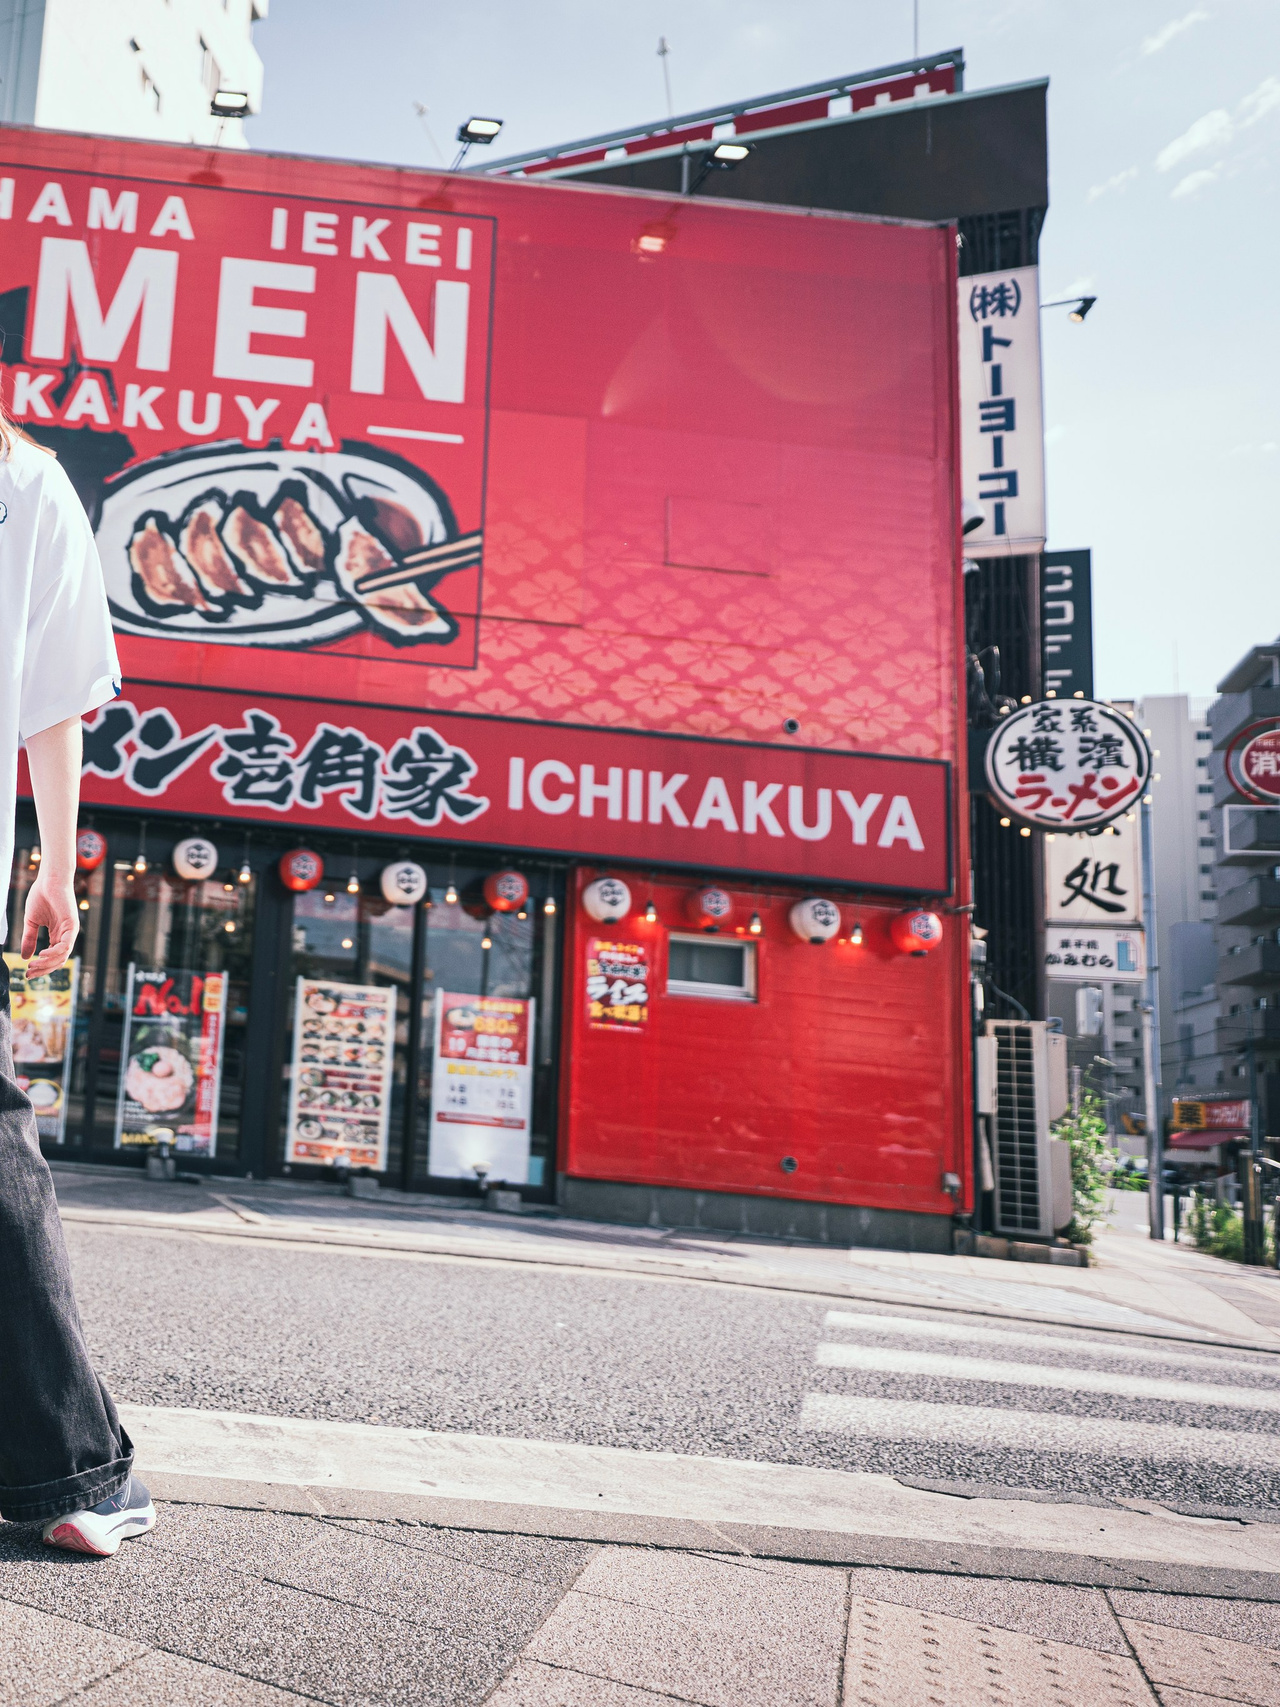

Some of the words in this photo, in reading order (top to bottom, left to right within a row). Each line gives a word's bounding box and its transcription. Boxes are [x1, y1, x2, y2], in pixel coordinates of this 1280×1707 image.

[270, 207, 473, 270] IEKEI
[1031, 703, 1099, 733] 家系
[1005, 733, 1129, 772] 横濱
[508, 756, 925, 852] ICHIKAKUYA
[1015, 773, 1140, 820] ラーメン
[1061, 828, 1128, 913] 処
